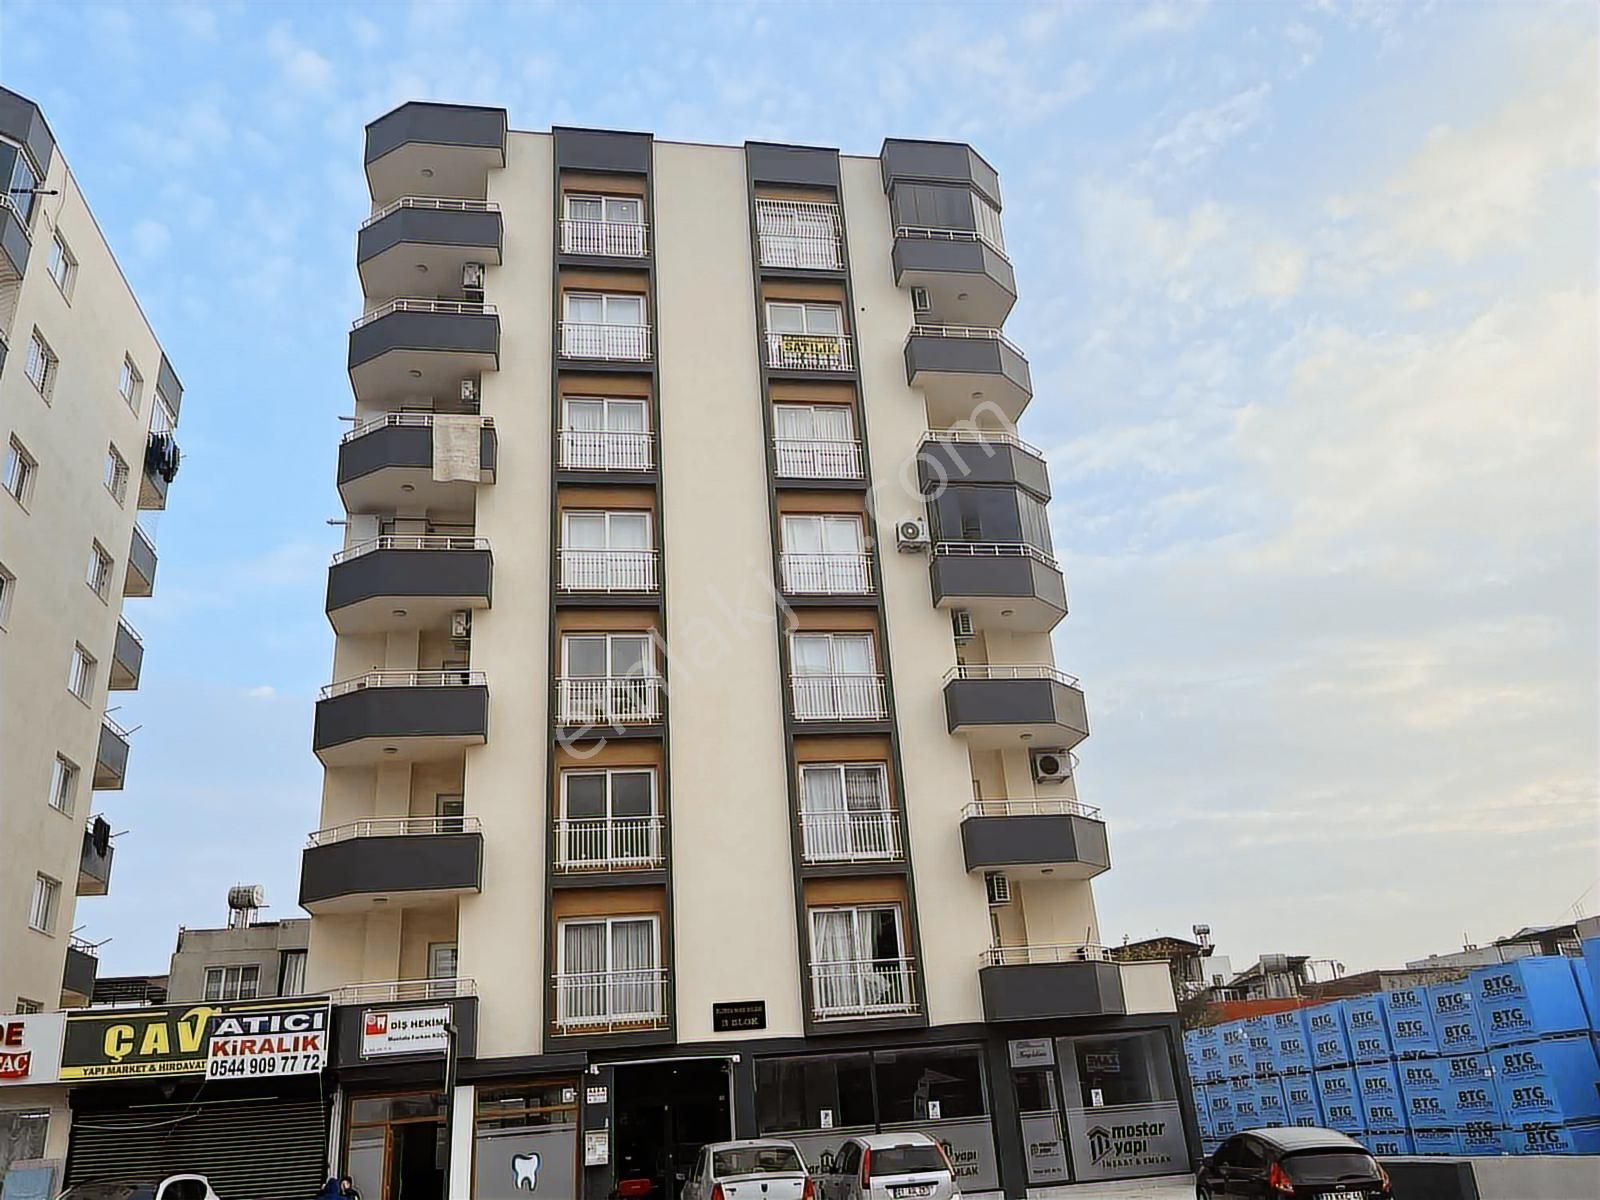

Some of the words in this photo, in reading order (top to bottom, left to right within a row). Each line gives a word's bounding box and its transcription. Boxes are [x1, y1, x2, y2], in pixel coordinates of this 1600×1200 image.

[1482, 975, 1513, 990] BTG
[1392, 991, 1415, 1003] BTG
[1437, 993, 1462, 1007] BTG
[1312, 1014, 1331, 1027] BTG
[1352, 1011, 1374, 1023] BTG
[1492, 1008, 1523, 1023] BTG
[214, 1012, 324, 1035] ATICI
[1397, 1021, 1422, 1032] BTG
[0, 1022, 24, 1046] E
[1444, 1024, 1471, 1037] BTG
[1317, 1040, 1337, 1053] BTG
[1358, 1039, 1380, 1050] BTG
[210, 1058, 245, 1076] 0544
[249, 1057, 276, 1073] 909
[281, 1056, 298, 1072] 77
[302, 1054, 320, 1070] 72
[1451, 1057, 1478, 1071] BTG
[1504, 1052, 1534, 1067] BTG
[82, 1067, 105, 1076] YAPI
[107, 1064, 147, 1074] MARKET
[1407, 1069, 1433, 1079] BTG
[1324, 1078, 1346, 1089] BTG
[1365, 1078, 1387, 1089] BTG
[1458, 1090, 1486, 1102] BTG
[1513, 1087, 1545, 1101] BTG
[1412, 1098, 1439, 1109] BTG
[1329, 1106, 1352, 1117] BTG
[1370, 1107, 1393, 1117] BTG
[1111, 1121, 1165, 1138] mostar
[1526, 1131, 1559, 1144] BTG
[1114, 1139, 1147, 1156] yapı
[1376, 1143, 1398, 1153] BTG
[954, 1151, 977, 1162] yapı
